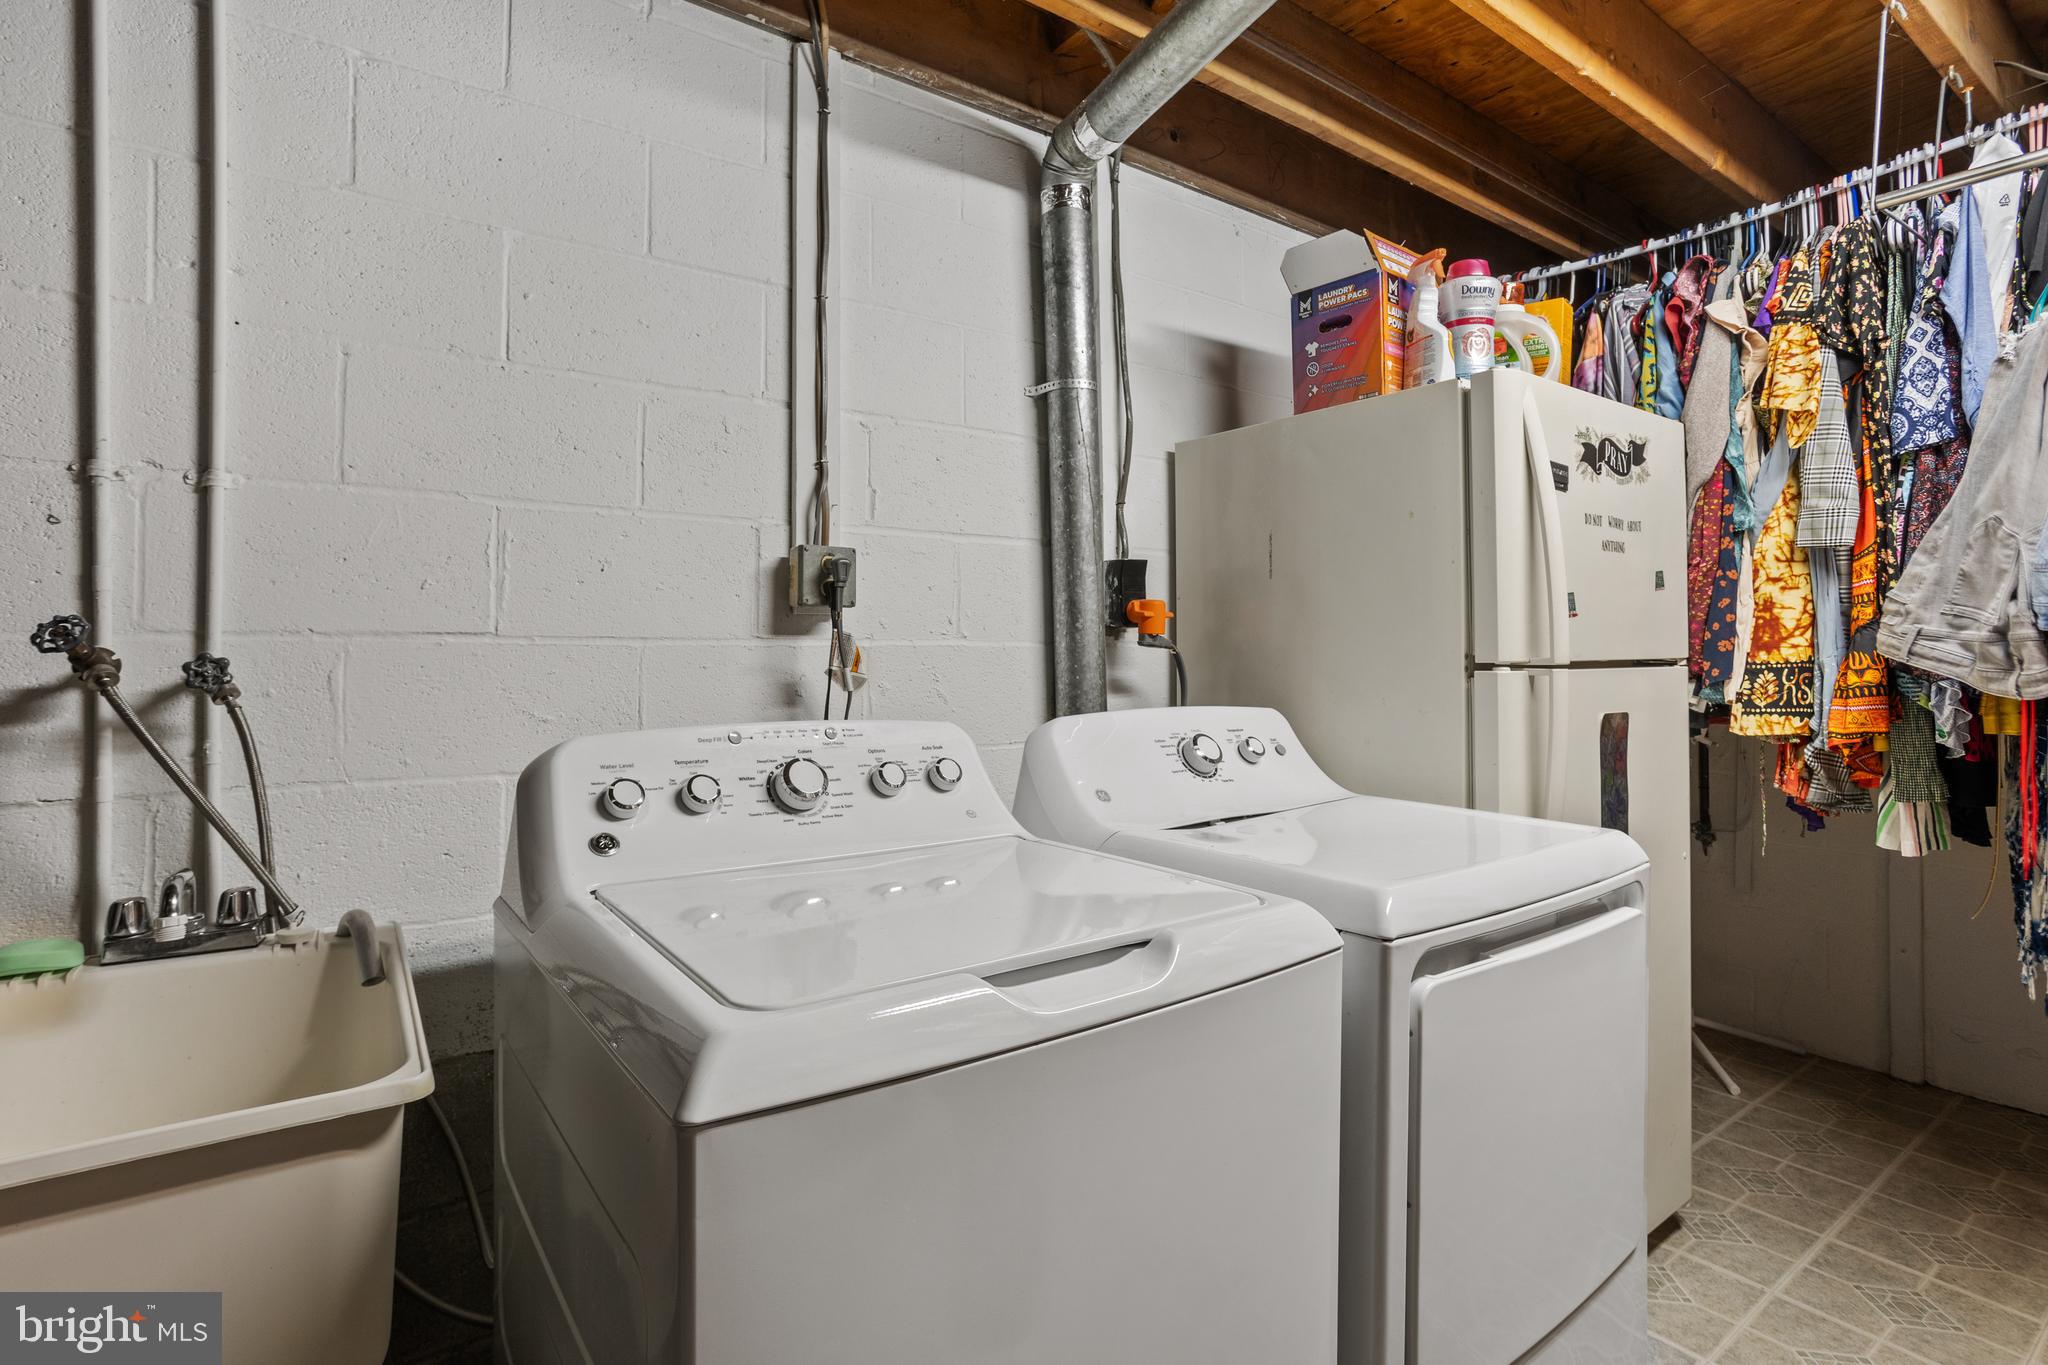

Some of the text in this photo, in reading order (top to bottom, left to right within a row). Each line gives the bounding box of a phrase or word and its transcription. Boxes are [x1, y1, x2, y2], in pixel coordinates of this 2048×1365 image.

[1318, 284, 1355, 301] LAUNDRY
[1318, 288, 1368, 310] POWER PACS
[1461, 285, 1496, 299] Downy
[1604, 440, 1628, 474] PRAY
[1584, 512, 1641, 532] DO NOT WORRY ABOUT
[1601, 540, 1625, 553] ANYTHING
